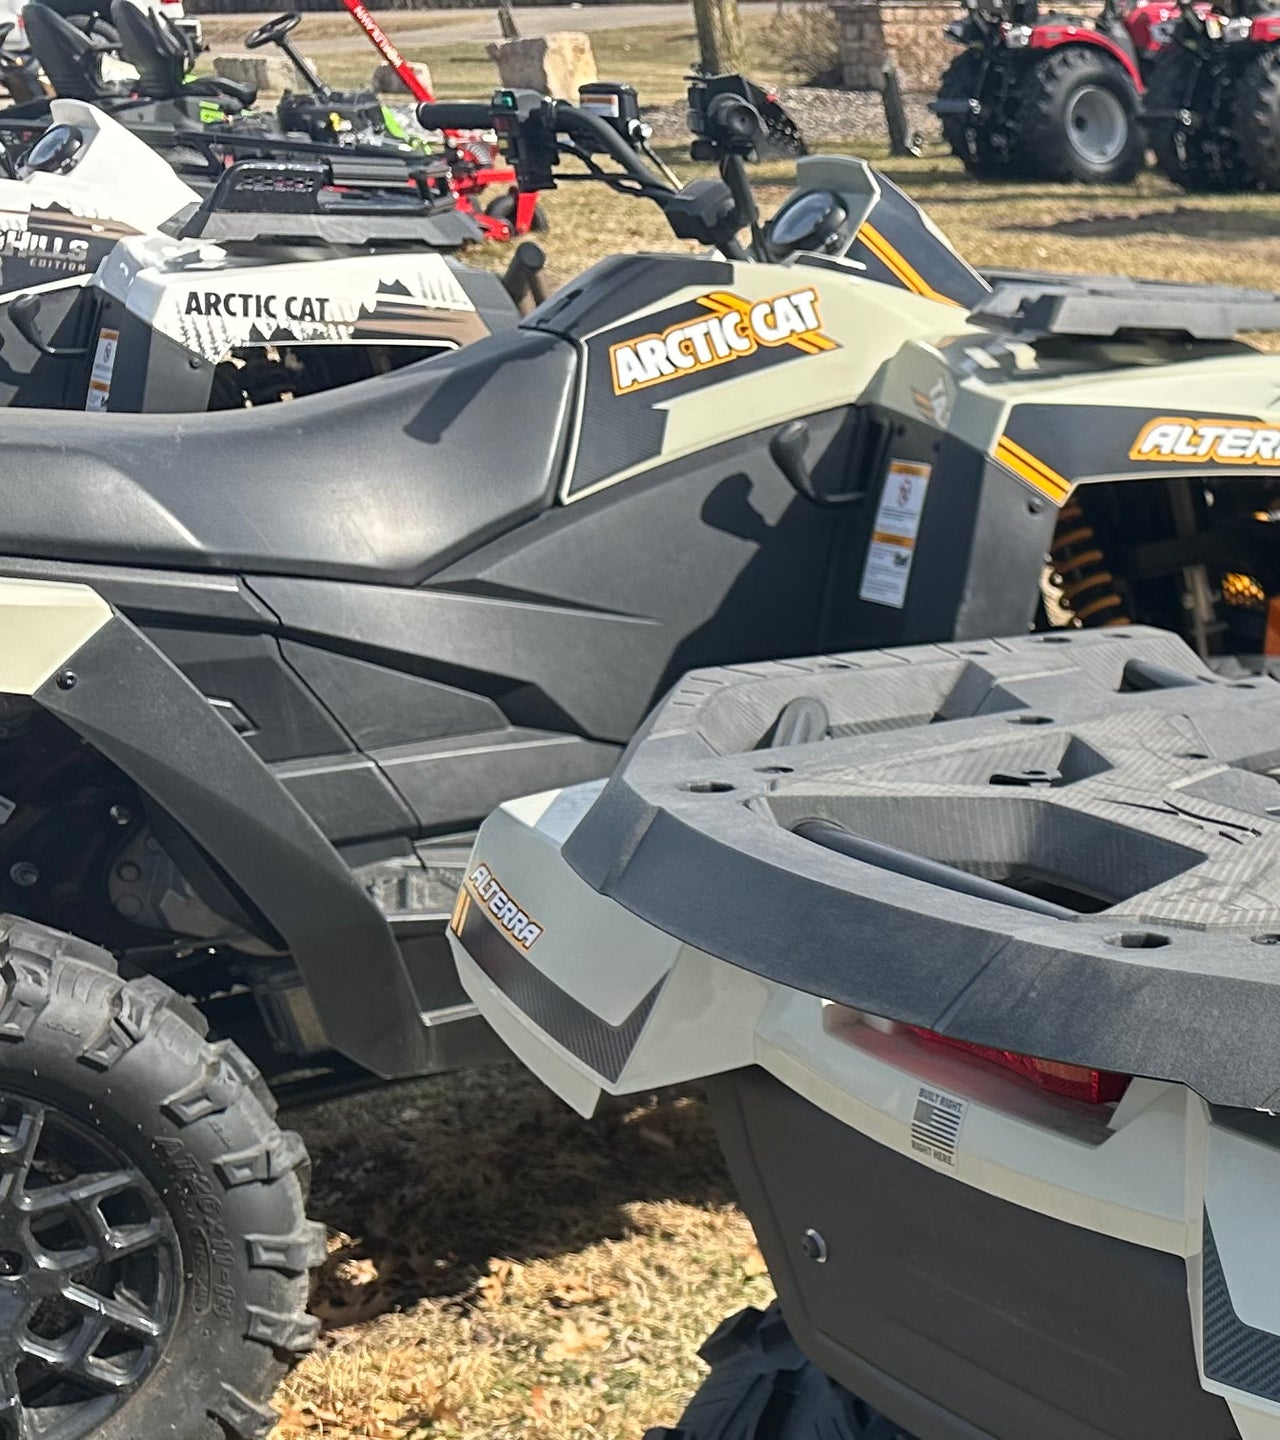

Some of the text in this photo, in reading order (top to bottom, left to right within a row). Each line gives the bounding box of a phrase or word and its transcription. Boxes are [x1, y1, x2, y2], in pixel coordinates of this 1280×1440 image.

[29, 257, 87, 272] EDITION
[184, 291, 330, 322] ARCTIC CAT
[613, 289, 822, 389] ARCTIC CAT
[470, 865, 543, 950] ALTERRA
